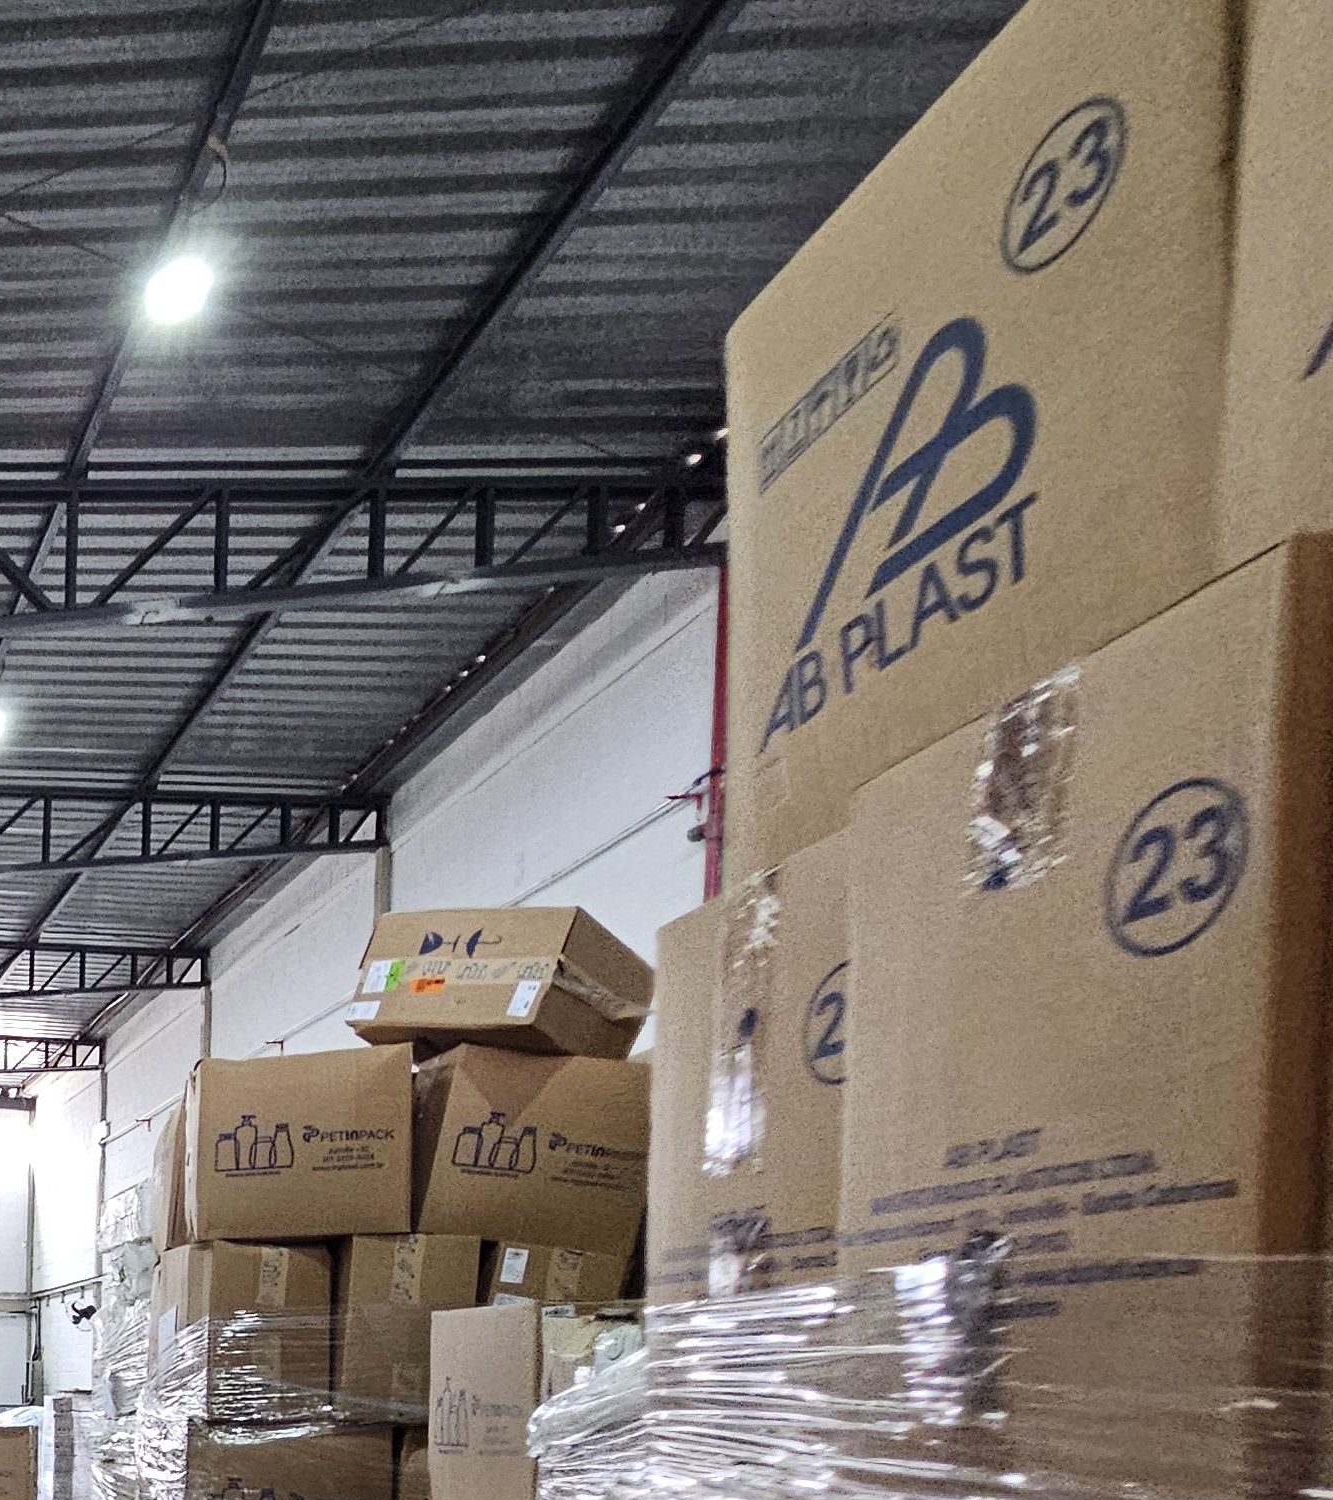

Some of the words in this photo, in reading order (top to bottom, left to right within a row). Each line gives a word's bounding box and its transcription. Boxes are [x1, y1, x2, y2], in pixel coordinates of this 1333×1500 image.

[1014, 115, 1114, 257] 23
[760, 650, 827, 754] AB
[840, 491, 1040, 695] PLAST
[1120, 804, 1234, 925] 23
[810, 991, 846, 1060] 2
